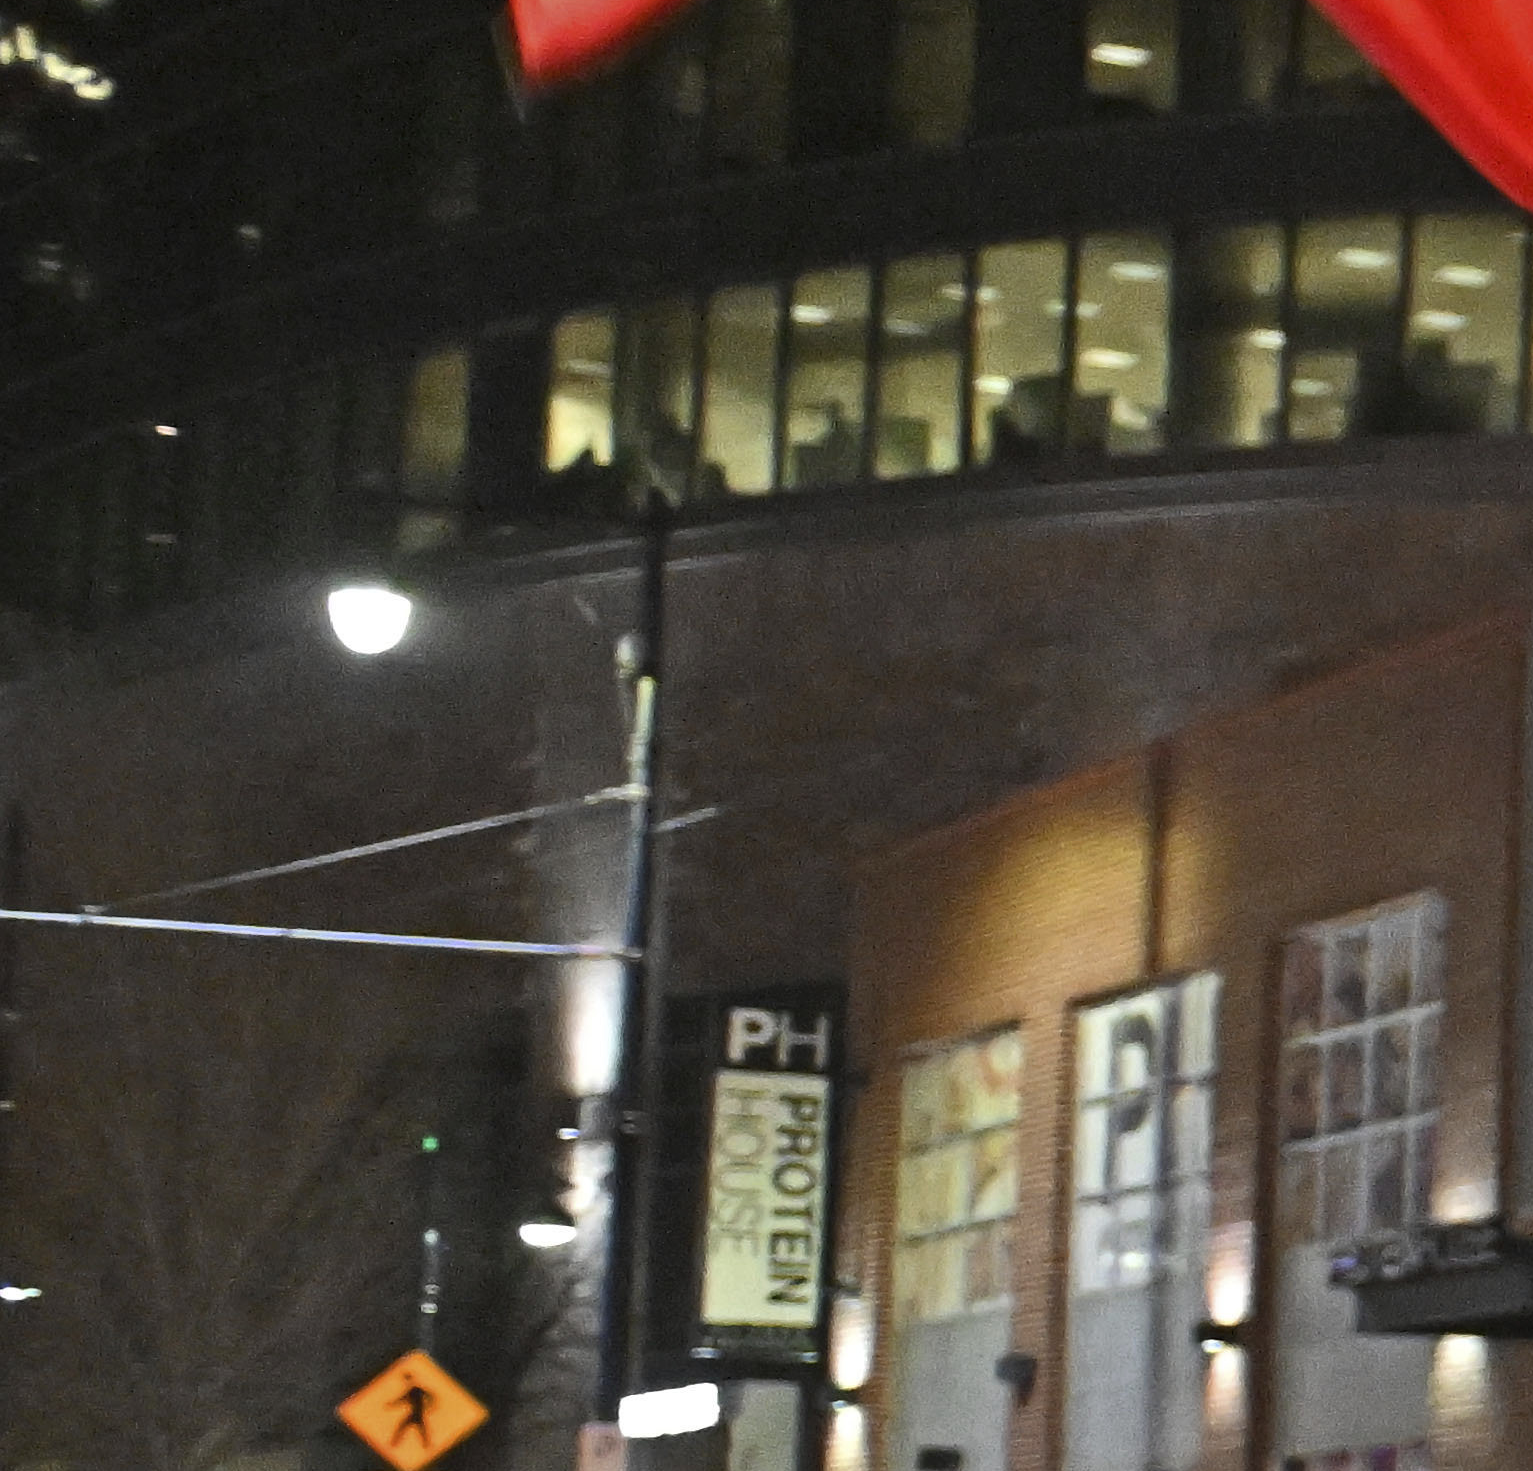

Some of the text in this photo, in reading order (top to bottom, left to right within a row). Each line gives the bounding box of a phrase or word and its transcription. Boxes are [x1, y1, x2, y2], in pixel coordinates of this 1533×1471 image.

[726, 1005, 830, 1070] PH
[711, 1088, 768, 1259] HOUSE
[765, 1093, 820, 1308] PROTEIN
